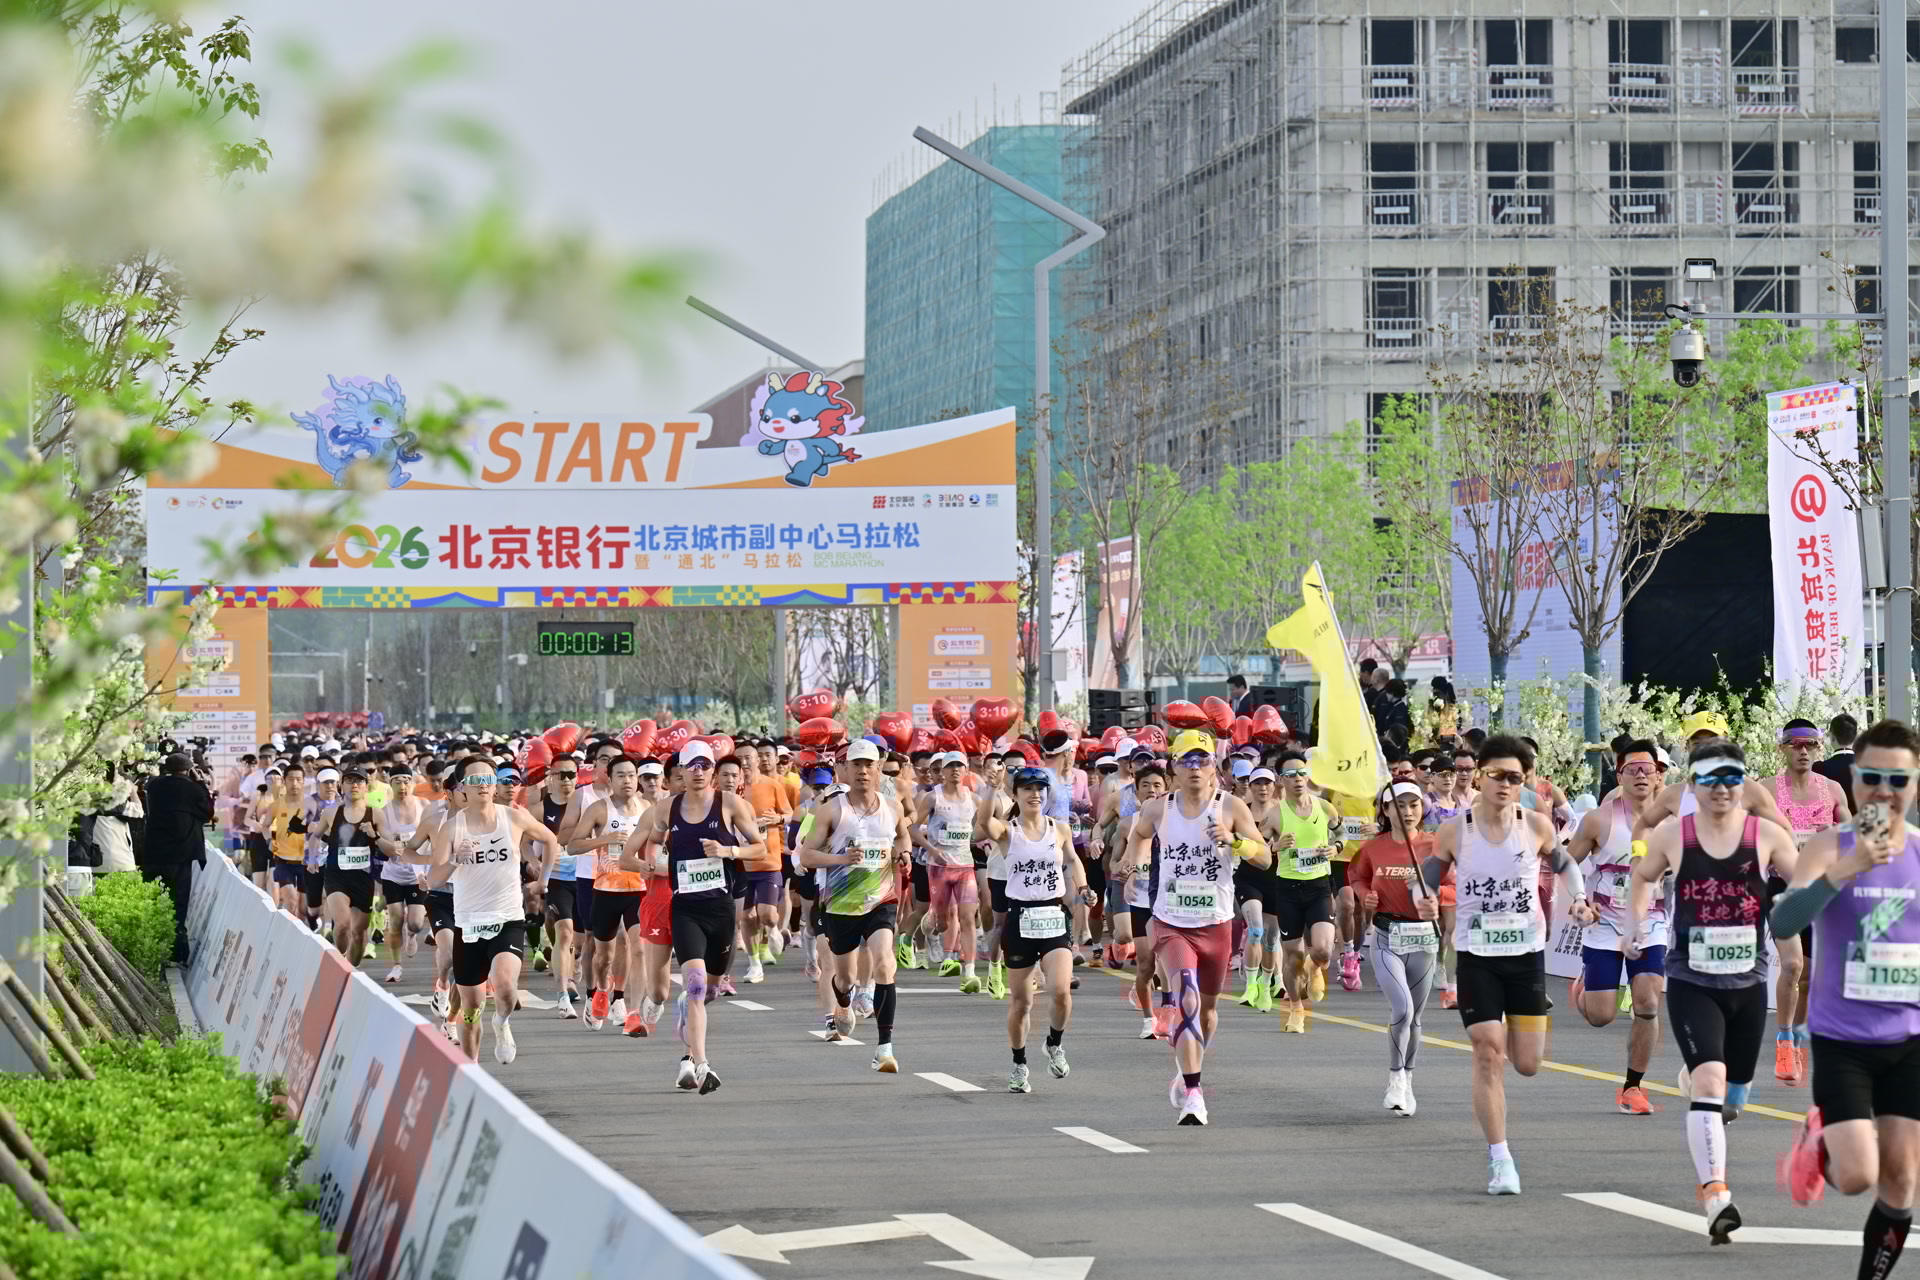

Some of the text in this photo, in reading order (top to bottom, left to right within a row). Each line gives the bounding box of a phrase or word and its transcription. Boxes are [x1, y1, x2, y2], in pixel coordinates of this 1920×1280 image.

[482, 421, 700, 483] START
[634, 522, 921, 551] 北京城市副中心马拉松
[309, 524, 631, 570] 2026 北京银行
[813, 551, 872, 560] BOB BEIJING
[814, 559, 885, 568] MC MARATHON
[540, 632, 632, 653] 00:00:13
[799, 694, 828, 709] 3:10
[979, 706, 1008, 718] 3:10
[888, 718, 913, 732] 3:10
[658, 727, 688, 748] 3:30
[864, 850, 887, 859] 1975
[1164, 842, 1215, 861] 北京通州
[679, 864, 687, 873] A
[1013, 859, 1055, 874] 北京通州
[1173, 857, 1222, 881] 长跑营
[689, 869, 722, 882] 10004
[1023, 870, 1059, 892] 长跑营
[1616, 877, 1625, 887] A
[1168, 883, 1176, 893] A
[1465, 877, 1523, 899] 北京通州
[1683, 877, 1749, 901] 北京通州
[1178, 895, 1214, 907] 10542
[1480, 888, 1533, 914] 长跑营
[1021, 910, 1030, 920] A
[1032, 919, 1063, 929] 20007
[1471, 918, 1482, 930] A
[1402, 935, 1437, 946] 20195
[1484, 931, 1524, 943] 12651
[1692, 931, 1705, 944] A
[1708, 945, 1752, 960] 10925
[1851, 947, 1866, 963] A
[1870, 967, 1918, 984] 11025
